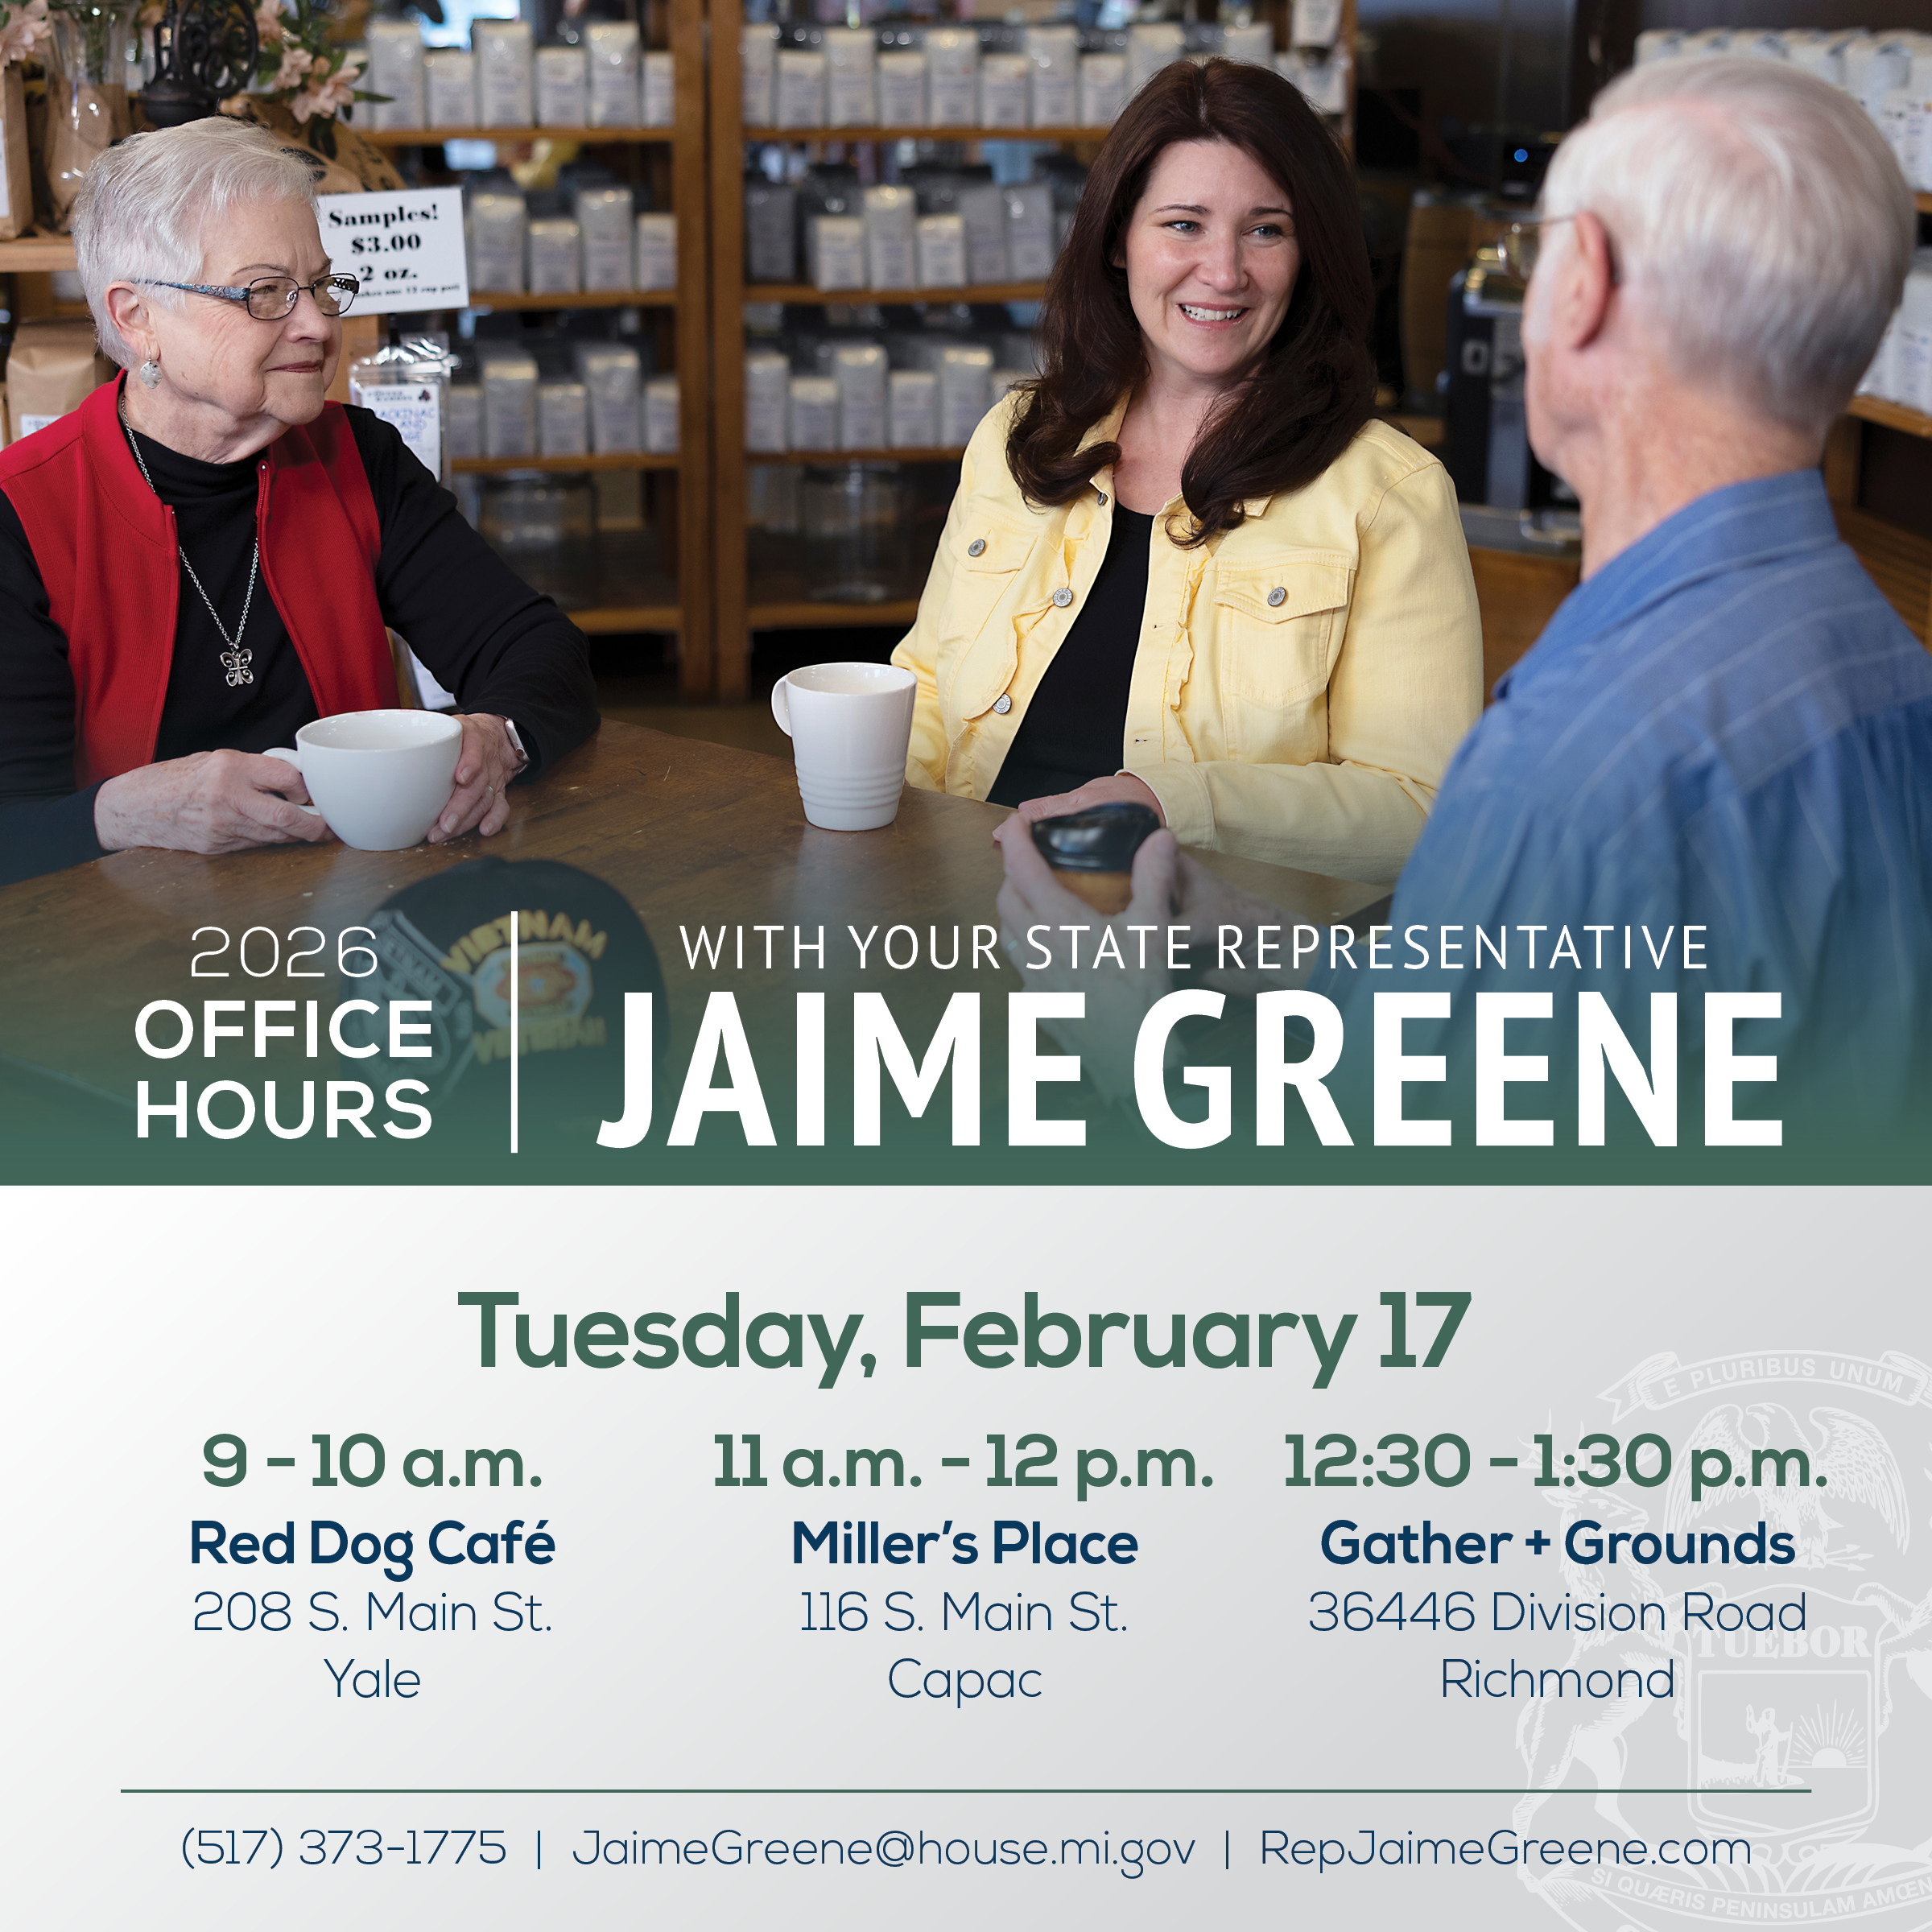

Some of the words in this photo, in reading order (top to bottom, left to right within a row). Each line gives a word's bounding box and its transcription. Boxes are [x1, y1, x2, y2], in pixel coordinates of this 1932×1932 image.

[328, 204, 438, 228] Samples!
[352, 234, 421, 254] $3.00
[360, 266, 373, 281] 2
[385, 269, 417, 279] oz.
